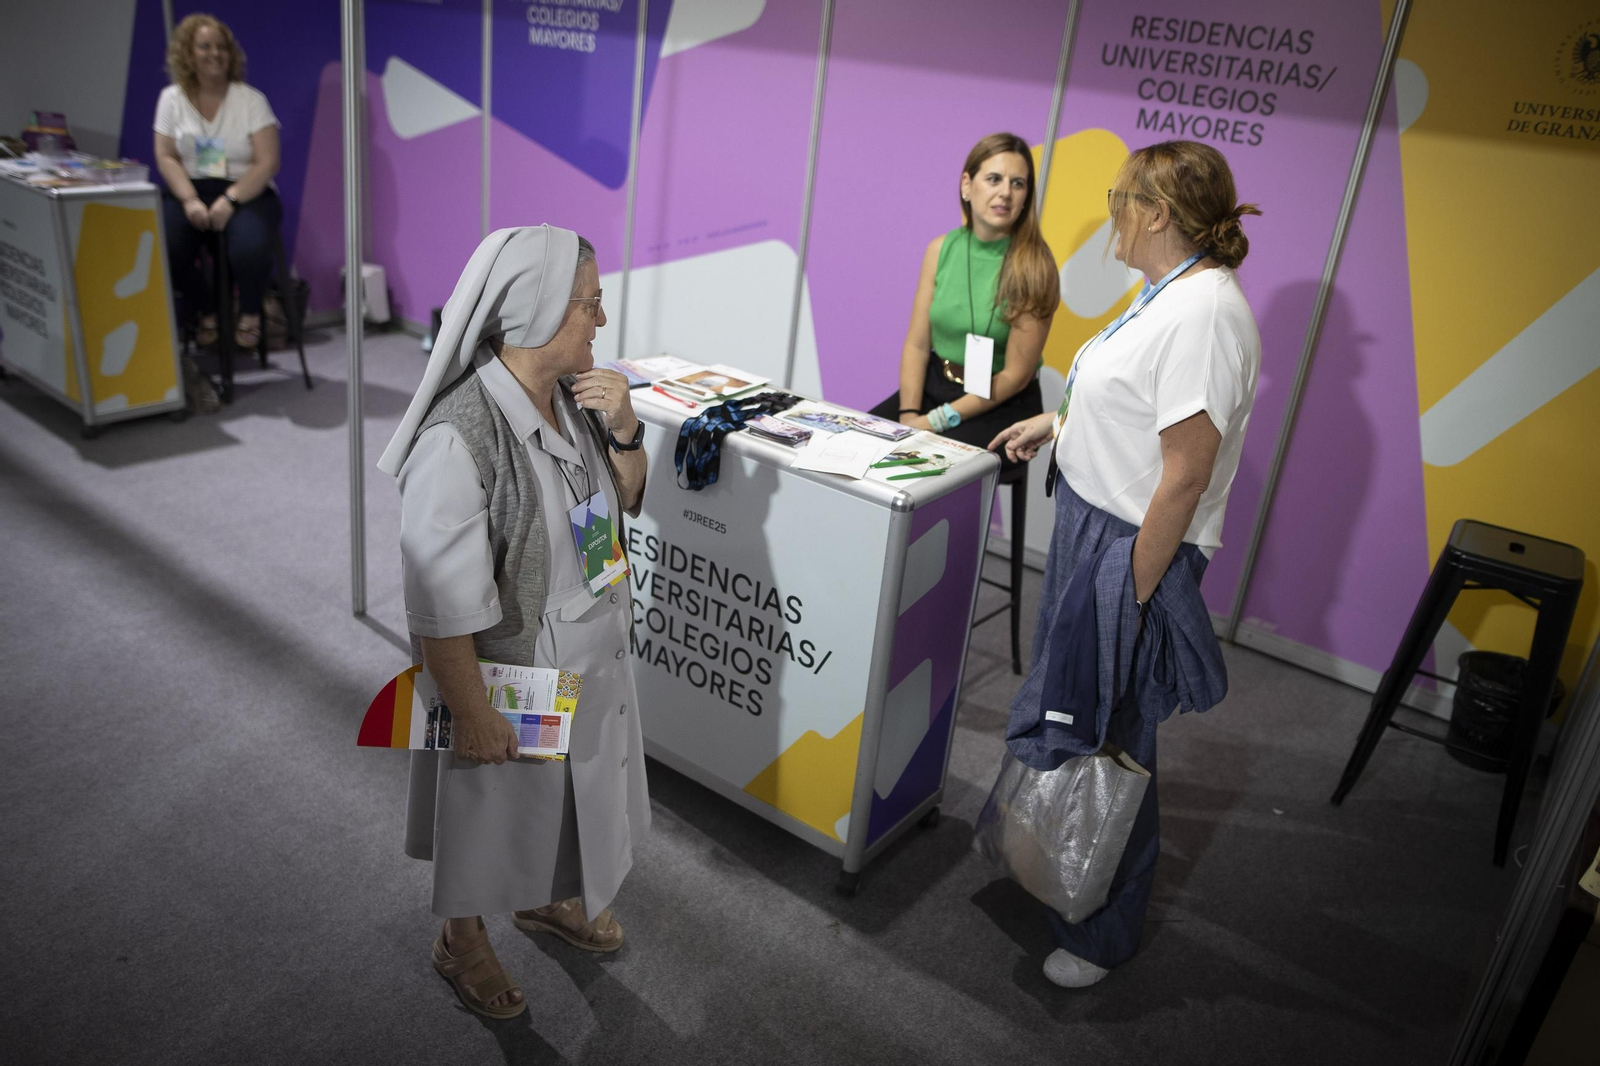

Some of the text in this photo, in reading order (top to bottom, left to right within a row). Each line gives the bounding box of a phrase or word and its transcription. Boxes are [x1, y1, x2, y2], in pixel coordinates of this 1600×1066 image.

[526, 5, 600, 31] COLEGIOS
[1131, 15, 1314, 55] RESIDENCIAS
[528, 26, 596, 53] MAYORES
[1101, 43, 1338, 92] UNIVERSITARIAS/
[1137, 78, 1277, 116] COLEGIOS
[1136, 108, 1264, 146] MAYORES
[1507, 119, 1531, 133] DE
[683, 508, 727, 534] #JJREE25
[627, 527, 803, 625] ESIDENCIAS
[631, 563, 833, 675] VERSITARIAS/
[630, 632, 764, 717] MAYORES
